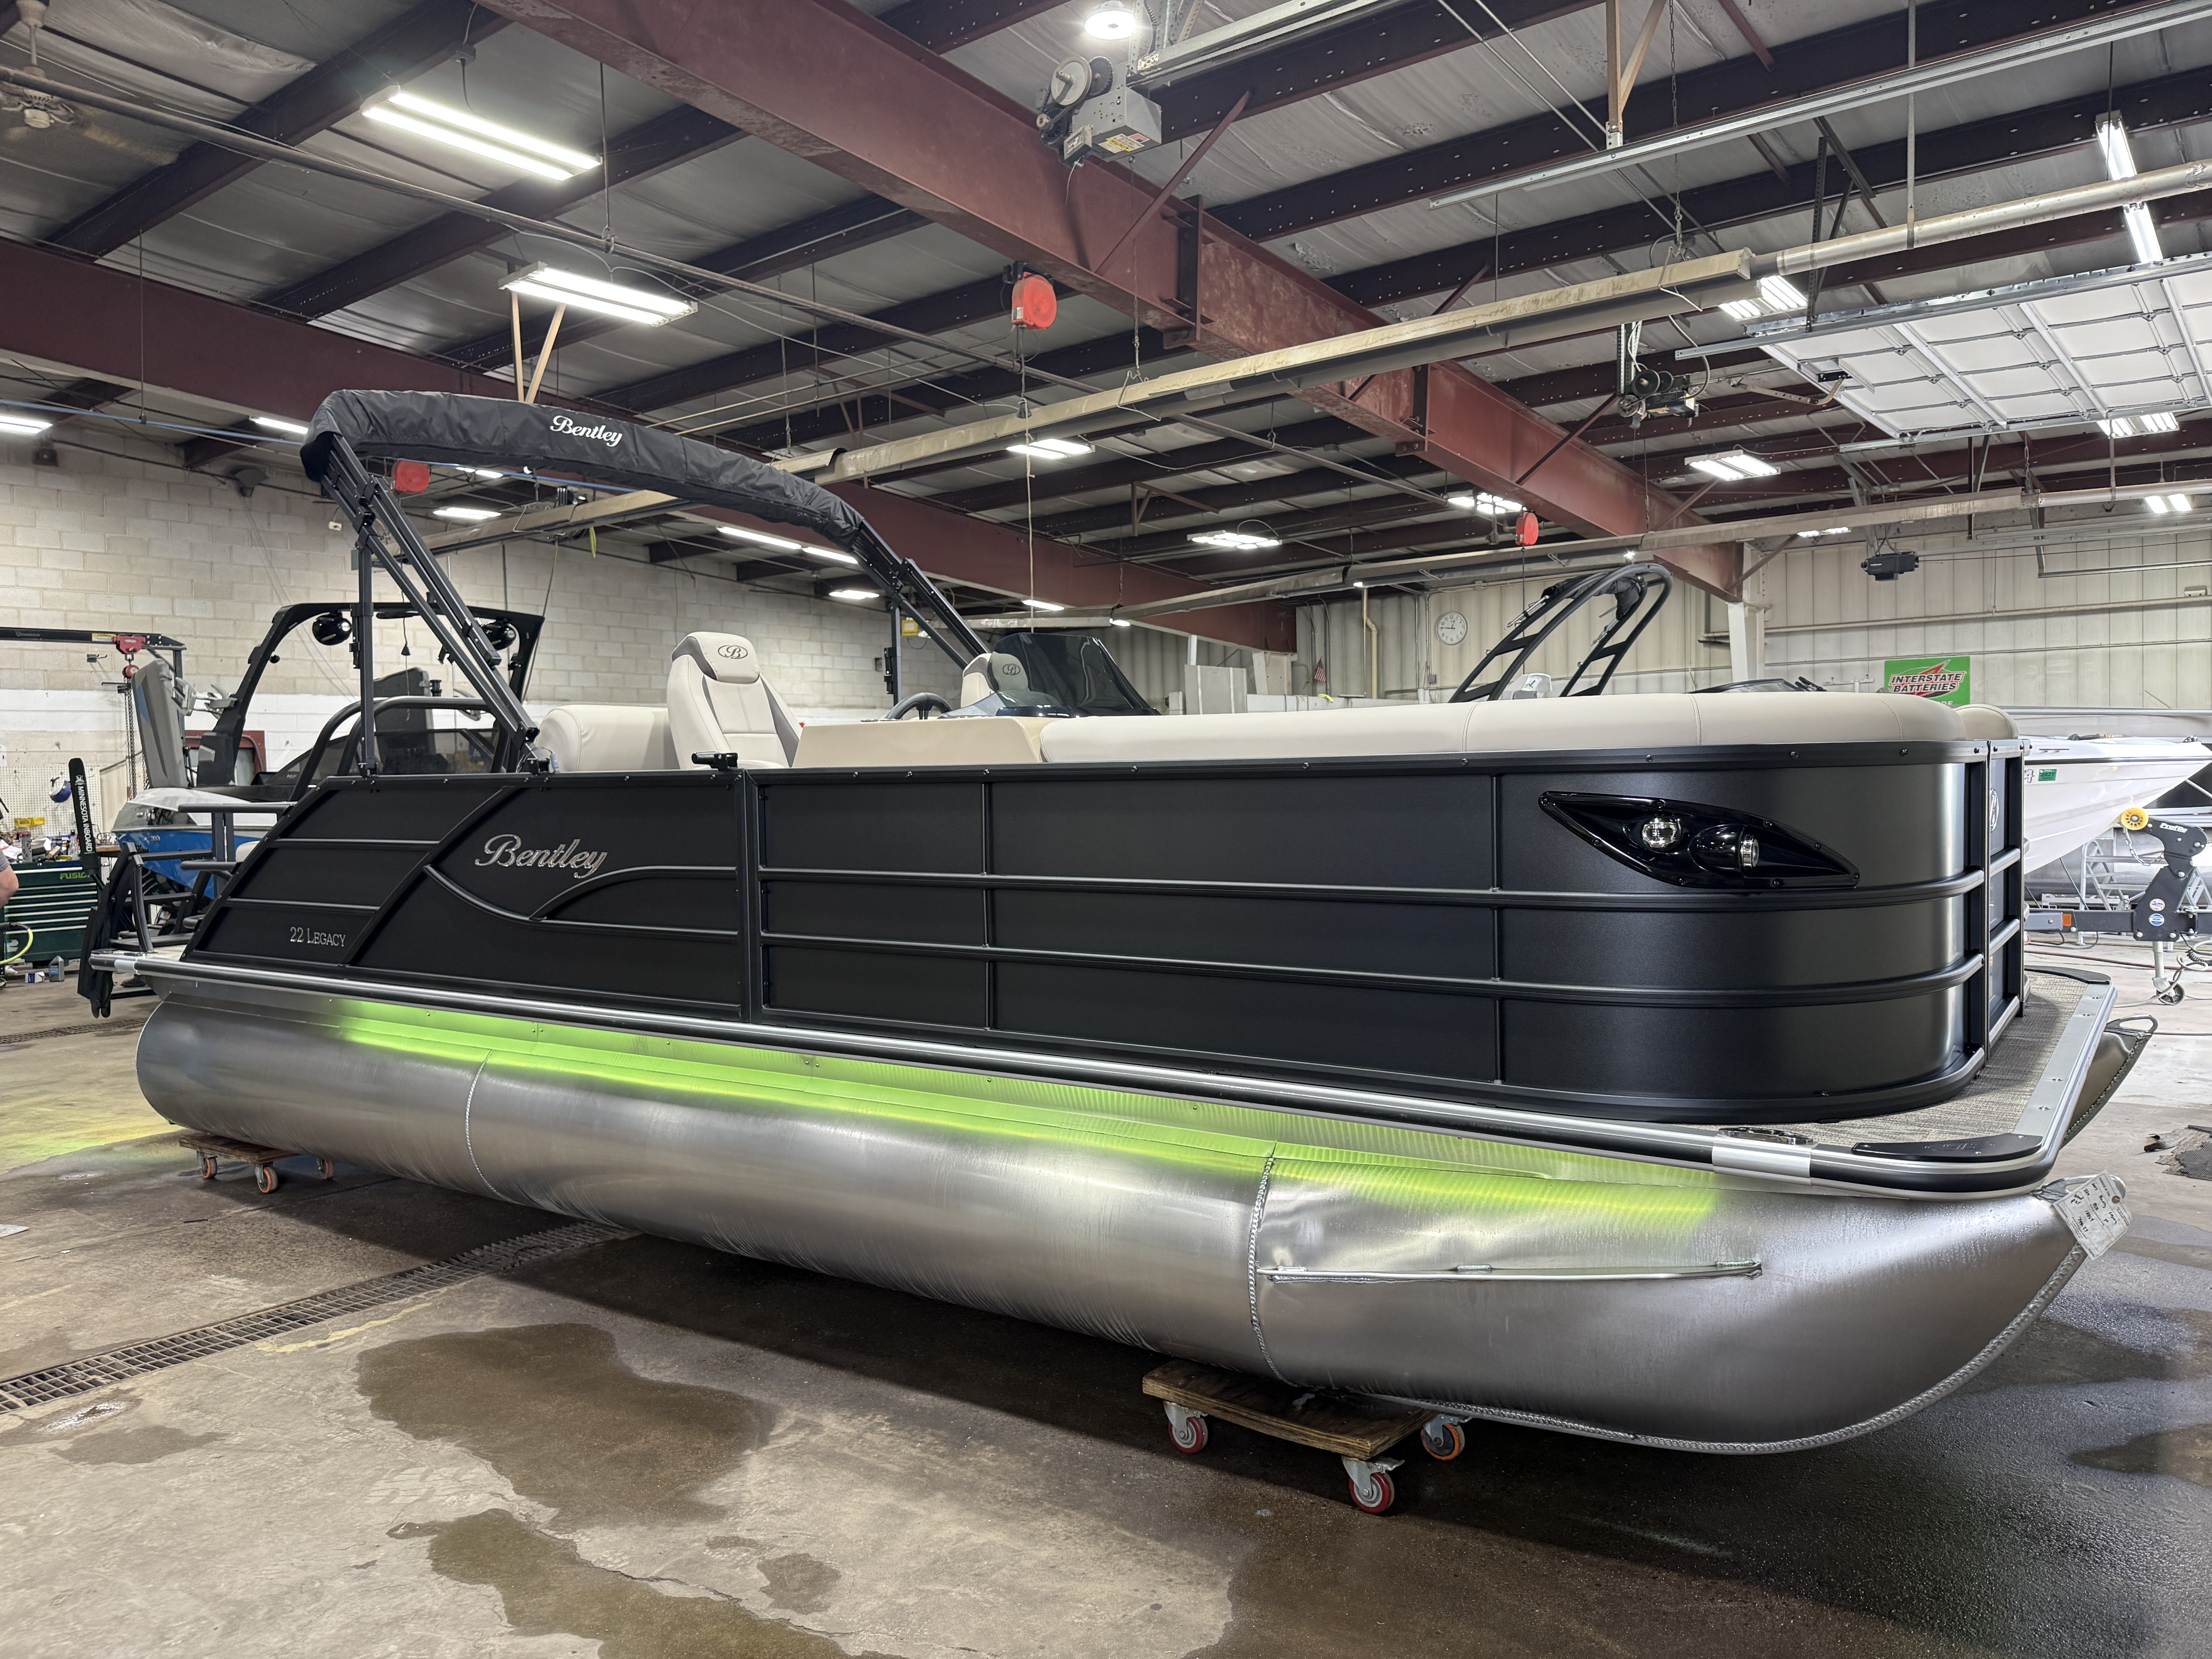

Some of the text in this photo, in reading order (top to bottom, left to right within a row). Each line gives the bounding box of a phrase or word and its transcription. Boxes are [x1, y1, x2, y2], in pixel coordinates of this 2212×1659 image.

[550, 416, 623, 447] Bentley
[1891, 673, 1962, 683] INTERSTATE
[1893, 683, 1956, 692] BATTERIES
[77, 786, 93, 852] MINNESOTA INBOARD
[475, 834, 608, 879] Bentley
[60, 871, 90, 880] FUSIO
[290, 926, 346, 947] 22 LEGACY
